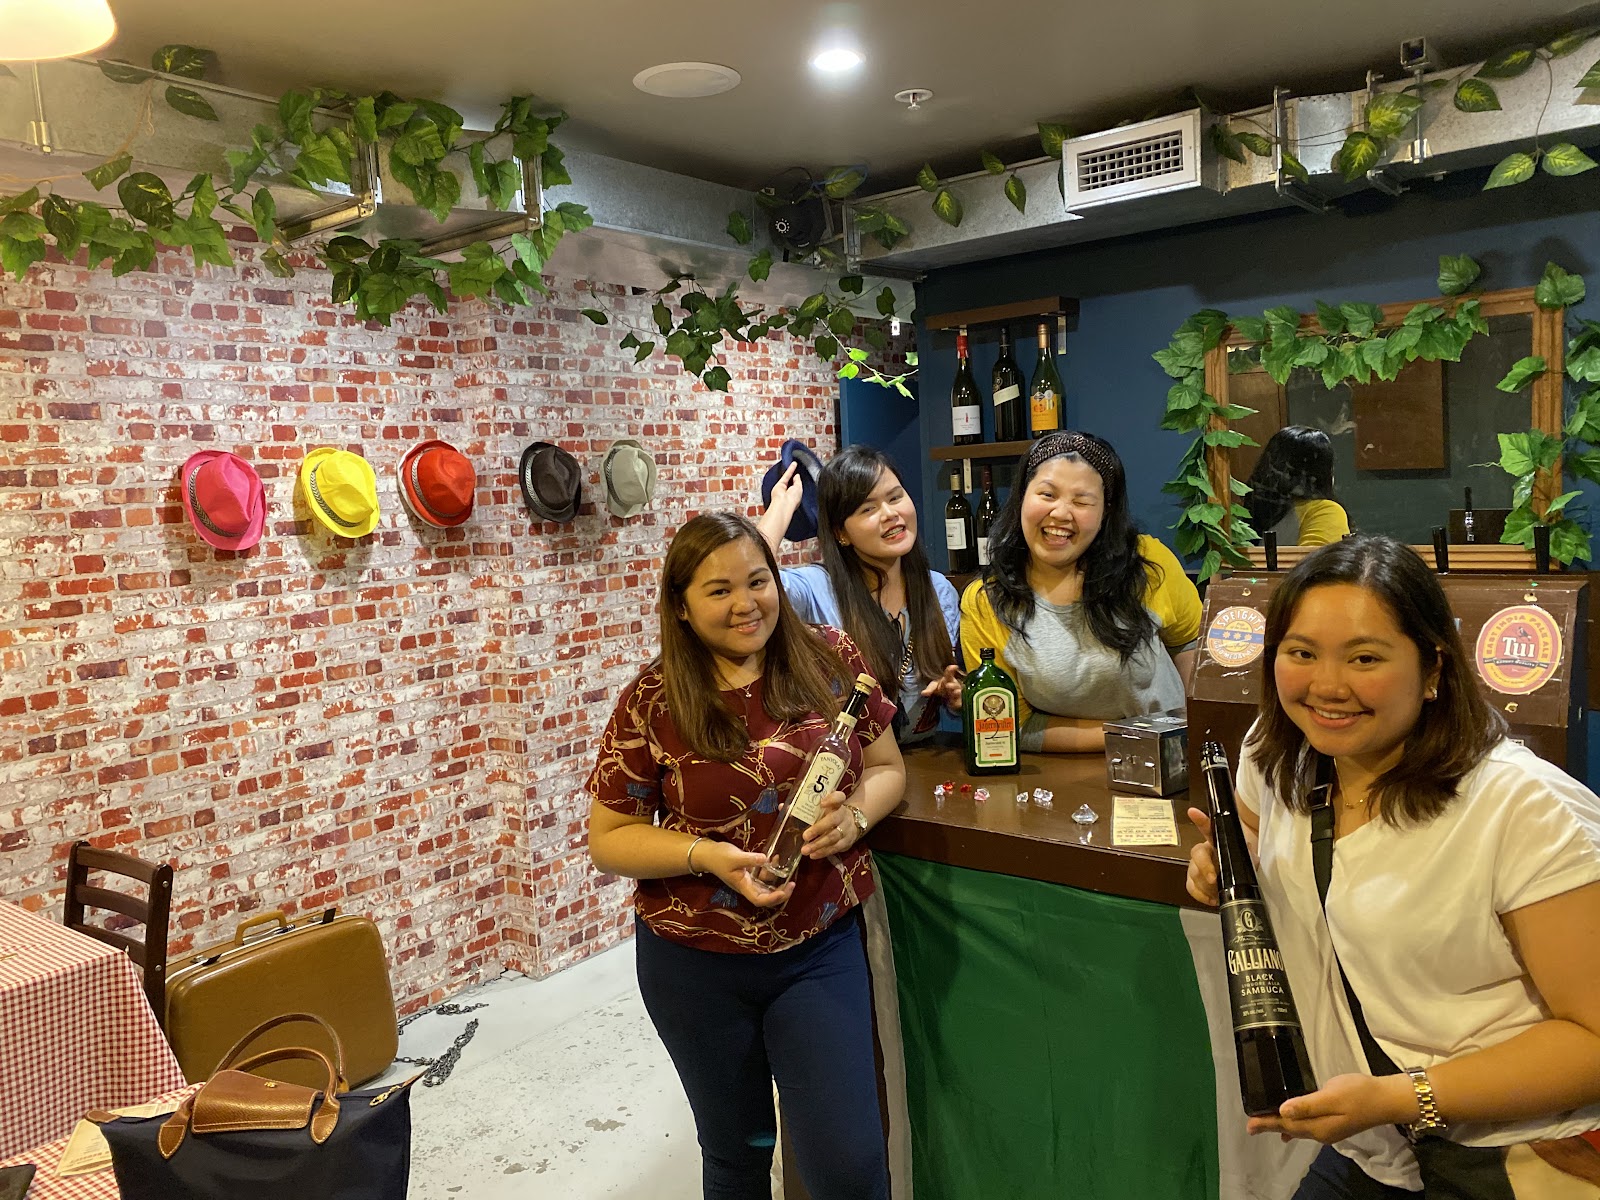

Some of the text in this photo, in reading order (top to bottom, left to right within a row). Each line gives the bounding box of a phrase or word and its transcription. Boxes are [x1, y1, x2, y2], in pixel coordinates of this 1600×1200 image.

[1486, 614, 1550, 660] EAST INDIA PALE ALE
[1502, 636, 1536, 658] Tui
[984, 717, 1009, 739] 2
[813, 774, 829, 793] 5
[1244, 911, 1254, 928] G
[1228, 948, 1284, 975] GALLIANO
[1245, 973, 1275, 982] BLACK
[1241, 986, 1285, 997] SAMBUCA
